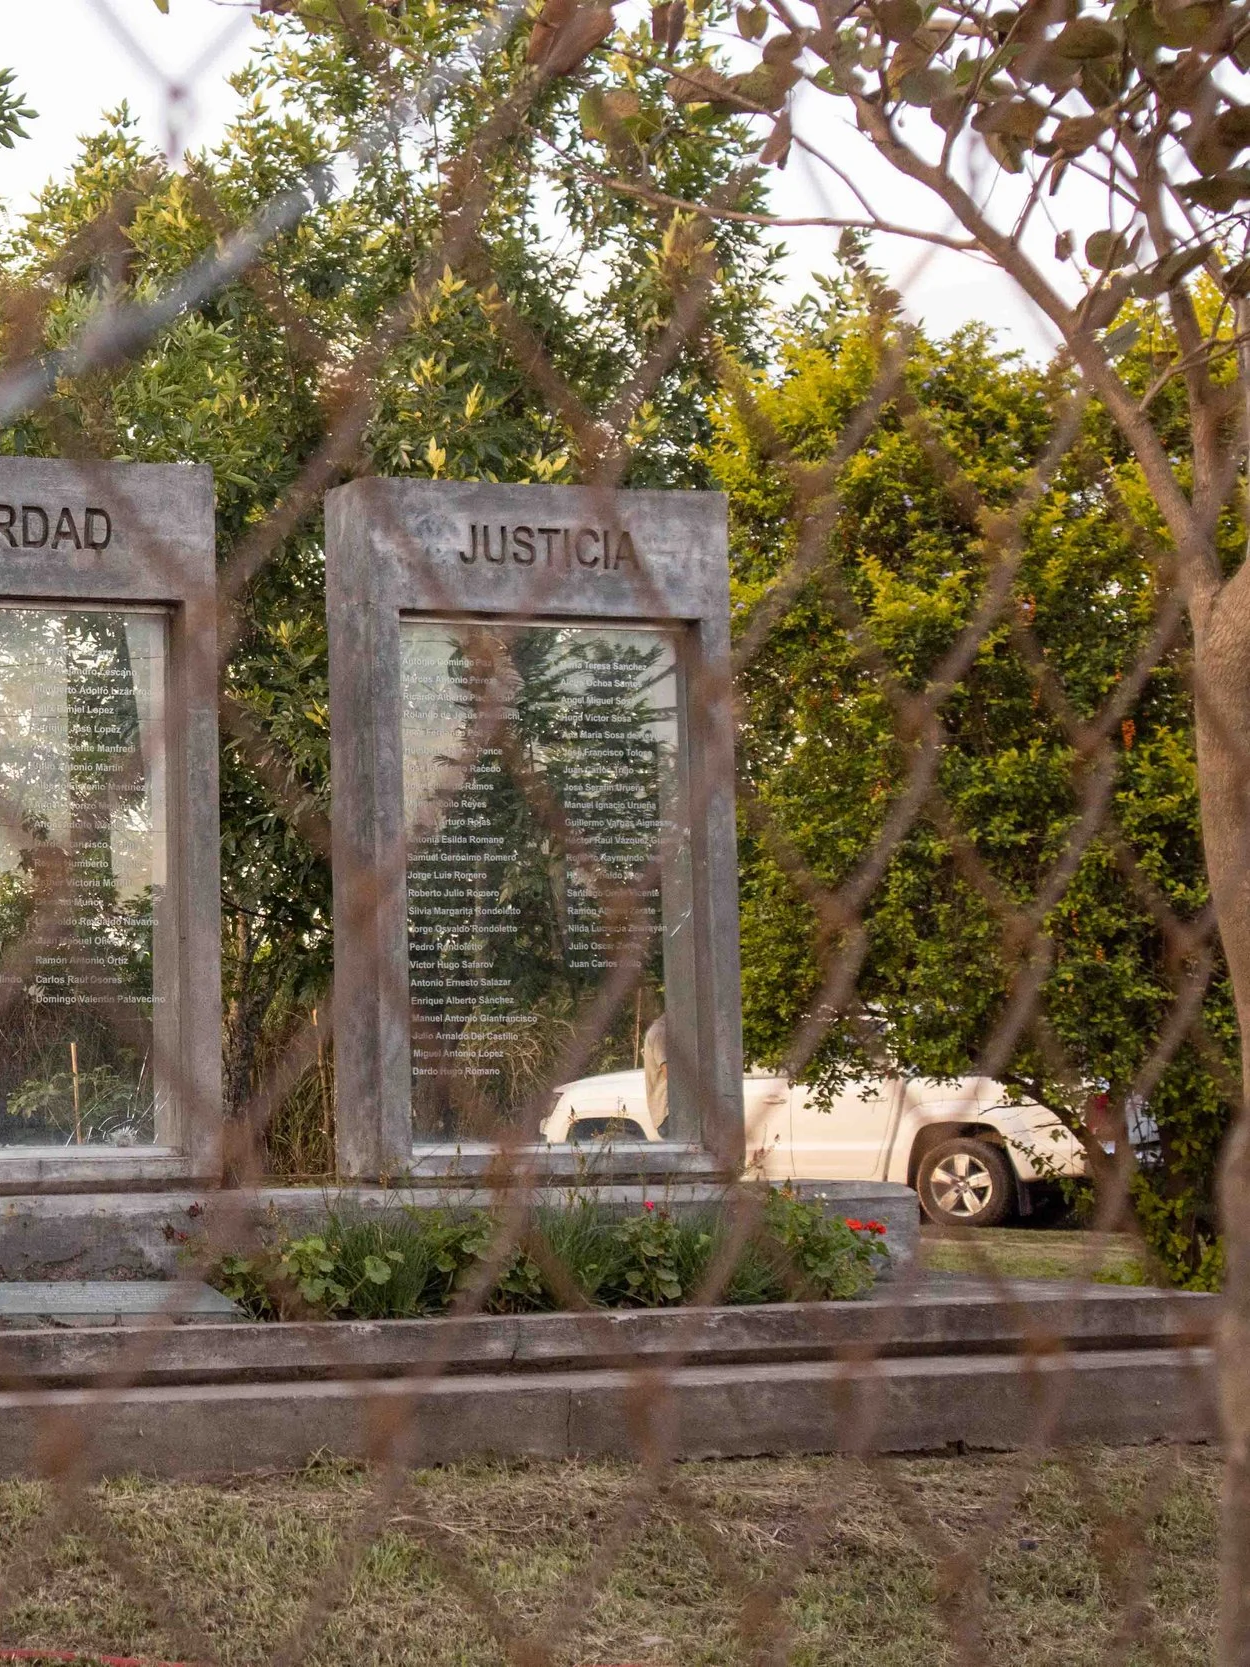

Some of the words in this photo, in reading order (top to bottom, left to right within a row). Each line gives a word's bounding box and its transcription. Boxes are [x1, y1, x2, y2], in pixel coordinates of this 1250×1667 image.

[459, 523, 640, 570] JUSTICIA
[402, 657, 435, 666] Antonio
[437, 658, 474, 668] Domingo
[584, 661, 611, 670] Teresa
[586, 679, 612, 687] Ochoa
[79, 686, 109, 695] Adolfo
[437, 693, 468, 702] Alberto
[586, 697, 614, 706] Miguel
[403, 710, 438, 719] Rolando
[611, 714, 632, 723] Sosa
[604, 730, 625, 739] Sosa
[96, 744, 136, 753] Manfredi
[476, 747, 503, 756] Ponce
[583, 748, 624, 757] Francisco
[469, 765, 502, 773] Racedo
[465, 782, 494, 791] Ramos
[461, 800, 487, 810] Reyes
[564, 801, 594, 809] Manuel
[595, 801, 625, 811] Ignacio
[627, 800, 656, 810] Urueña
[467, 818, 491, 828] Rojas
[565, 818, 605, 827] Guillermo
[606, 819, 635, 829] Vargas
[441, 835, 467, 844] Esilda
[469, 836, 505, 845] Romano
[407, 853, 439, 862] Samuel
[483, 853, 517, 862] Romero
[407, 871, 432, 881] Jorge
[434, 871, 452, 880] Luis
[454, 872, 487, 880] Romero
[66, 879, 101, 887] Victoria
[408, 889, 442, 897] Roberto
[443, 889, 465, 898] Julio
[466, 889, 500, 898] Romero
[408, 907, 432, 915] Silvia
[433, 907, 473, 917] Margarita
[475, 907, 522, 915] Rondoletto
[124, 918, 159, 926] Navarro
[435, 924, 471, 933] Osvaldo
[472, 925, 518, 933] Rondoletto
[568, 924, 589, 933] Nilda
[409, 942, 435, 951] Pedro
[437, 942, 483, 951] Rondoletto
[568, 941, 589, 950] Julio
[35, 956, 67, 965] Ramón
[69, 956, 105, 965] Antonio
[569, 959, 590, 968] Juan
[591, 960, 618, 968] Carlos
[437, 960, 460, 971] Hugo
[461, 960, 494, 969] Safarov
[35, 976, 65, 984] Carlos
[410, 978, 444, 987] Antonio
[446, 978, 479, 987] Ernesto
[480, 978, 512, 987] Salazar
[36, 995, 77, 1006] Domingo
[117, 995, 166, 1004] Palavecino
[411, 996, 444, 1006] Enrique
[445, 996, 477, 1005] Alberto
[478, 996, 515, 1005] Sánchez
[412, 1014, 443, 1023] Manuel
[444, 1014, 478, 1023] Antonio
[479, 1014, 538, 1024] Gianfrancisco
[412, 1032, 434, 1040] Julio
[435, 1032, 469, 1041] Arnaldo
[486, 1032, 519, 1041] Castillo
[413, 1049, 441, 1059] Miguel
[443, 1049, 477, 1058] Antonio
[412, 1067, 439, 1075] Dardo
[465, 1067, 501, 1076] Romano
